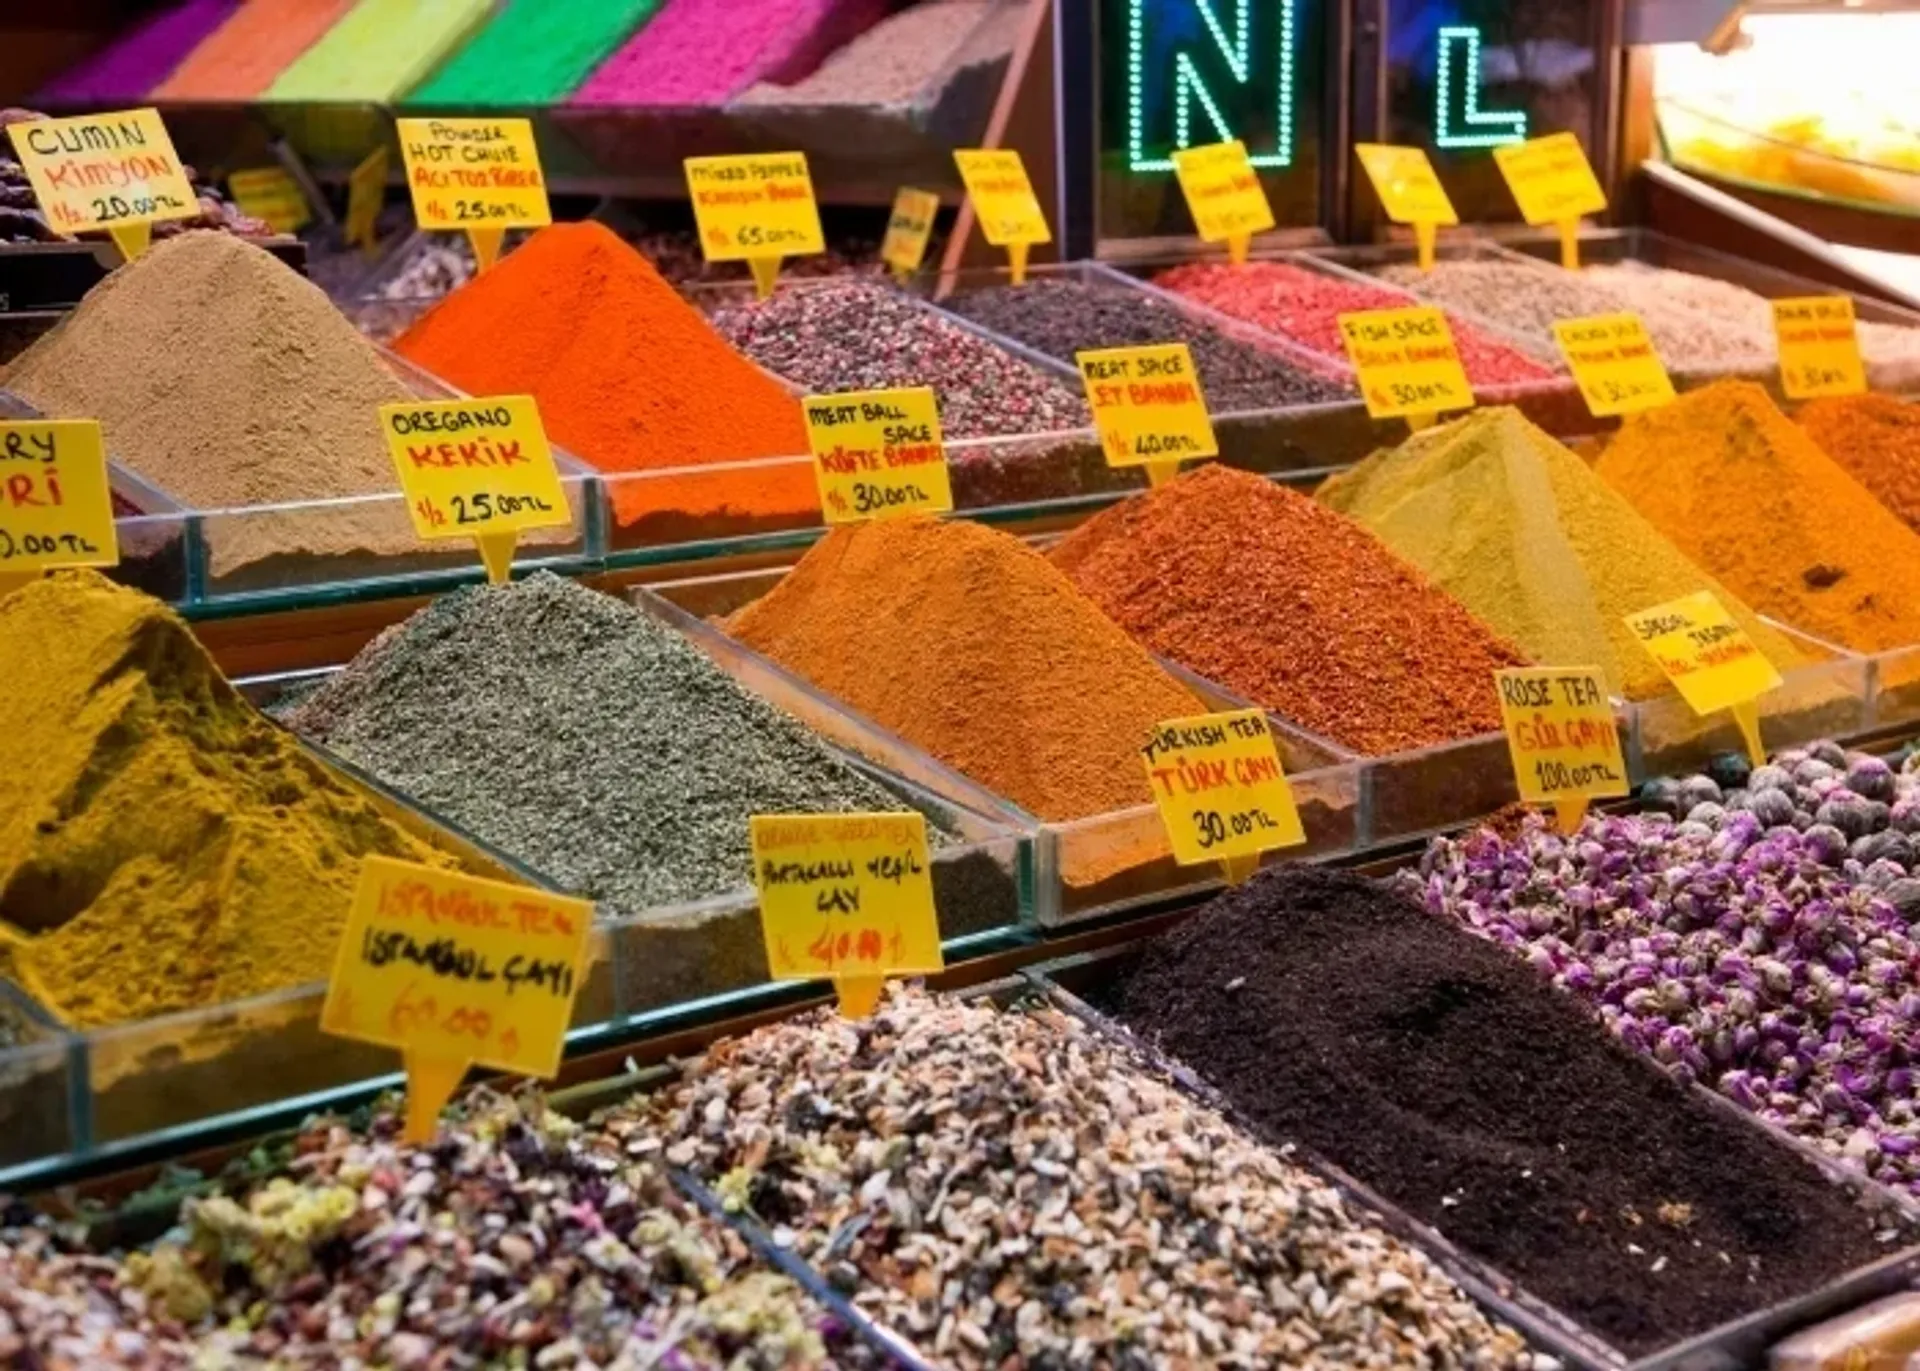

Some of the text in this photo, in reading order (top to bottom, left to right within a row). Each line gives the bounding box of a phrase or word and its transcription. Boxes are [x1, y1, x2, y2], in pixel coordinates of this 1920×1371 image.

[1437, 27, 1526, 147] L
[27, 119, 147, 155] CUMIN
[408, 142, 454, 162] HOT
[1084, 353, 1185, 380] MEAT SPICE
[391, 406, 512, 435] OREGANO
[808, 402, 908, 426] MEAT BALL
[882, 424, 932, 445] SPICE
[416, 497, 448, 528] 1/2
[1501, 675, 1601, 708] ROSE TEA
[1228, 714, 1267, 740] TEA
[1151, 755, 1234, 797] TÜRK
